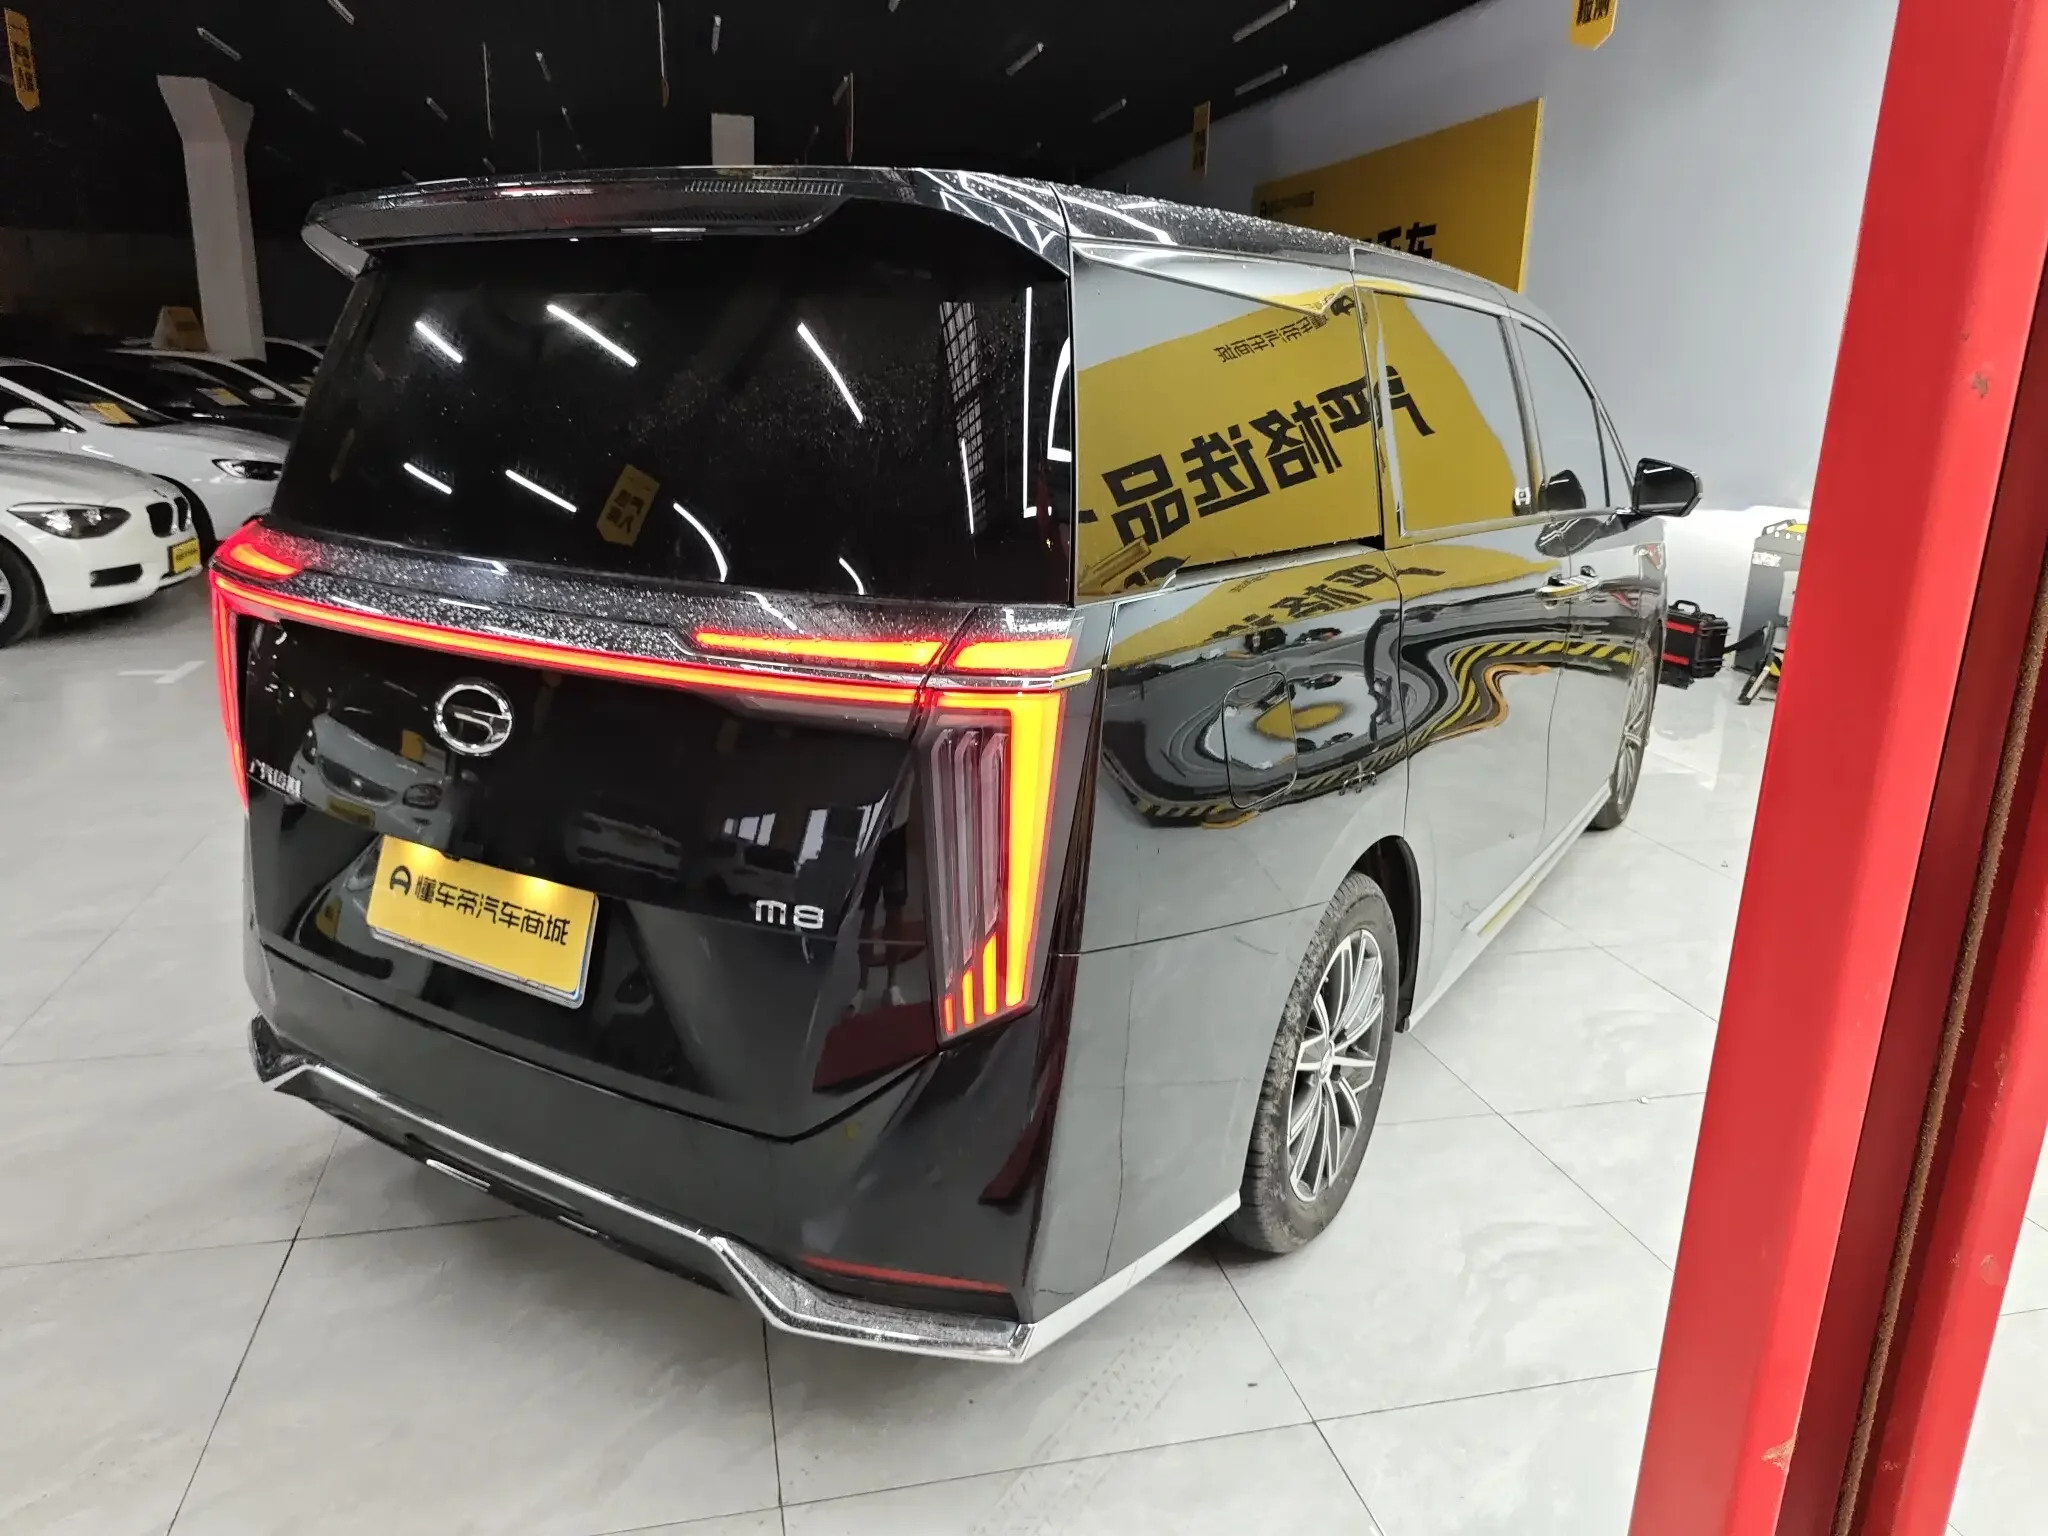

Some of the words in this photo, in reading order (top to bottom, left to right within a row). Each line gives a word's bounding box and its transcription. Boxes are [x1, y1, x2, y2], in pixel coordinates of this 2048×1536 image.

[415, 874, 571, 946] 懂车帝汽车商城
